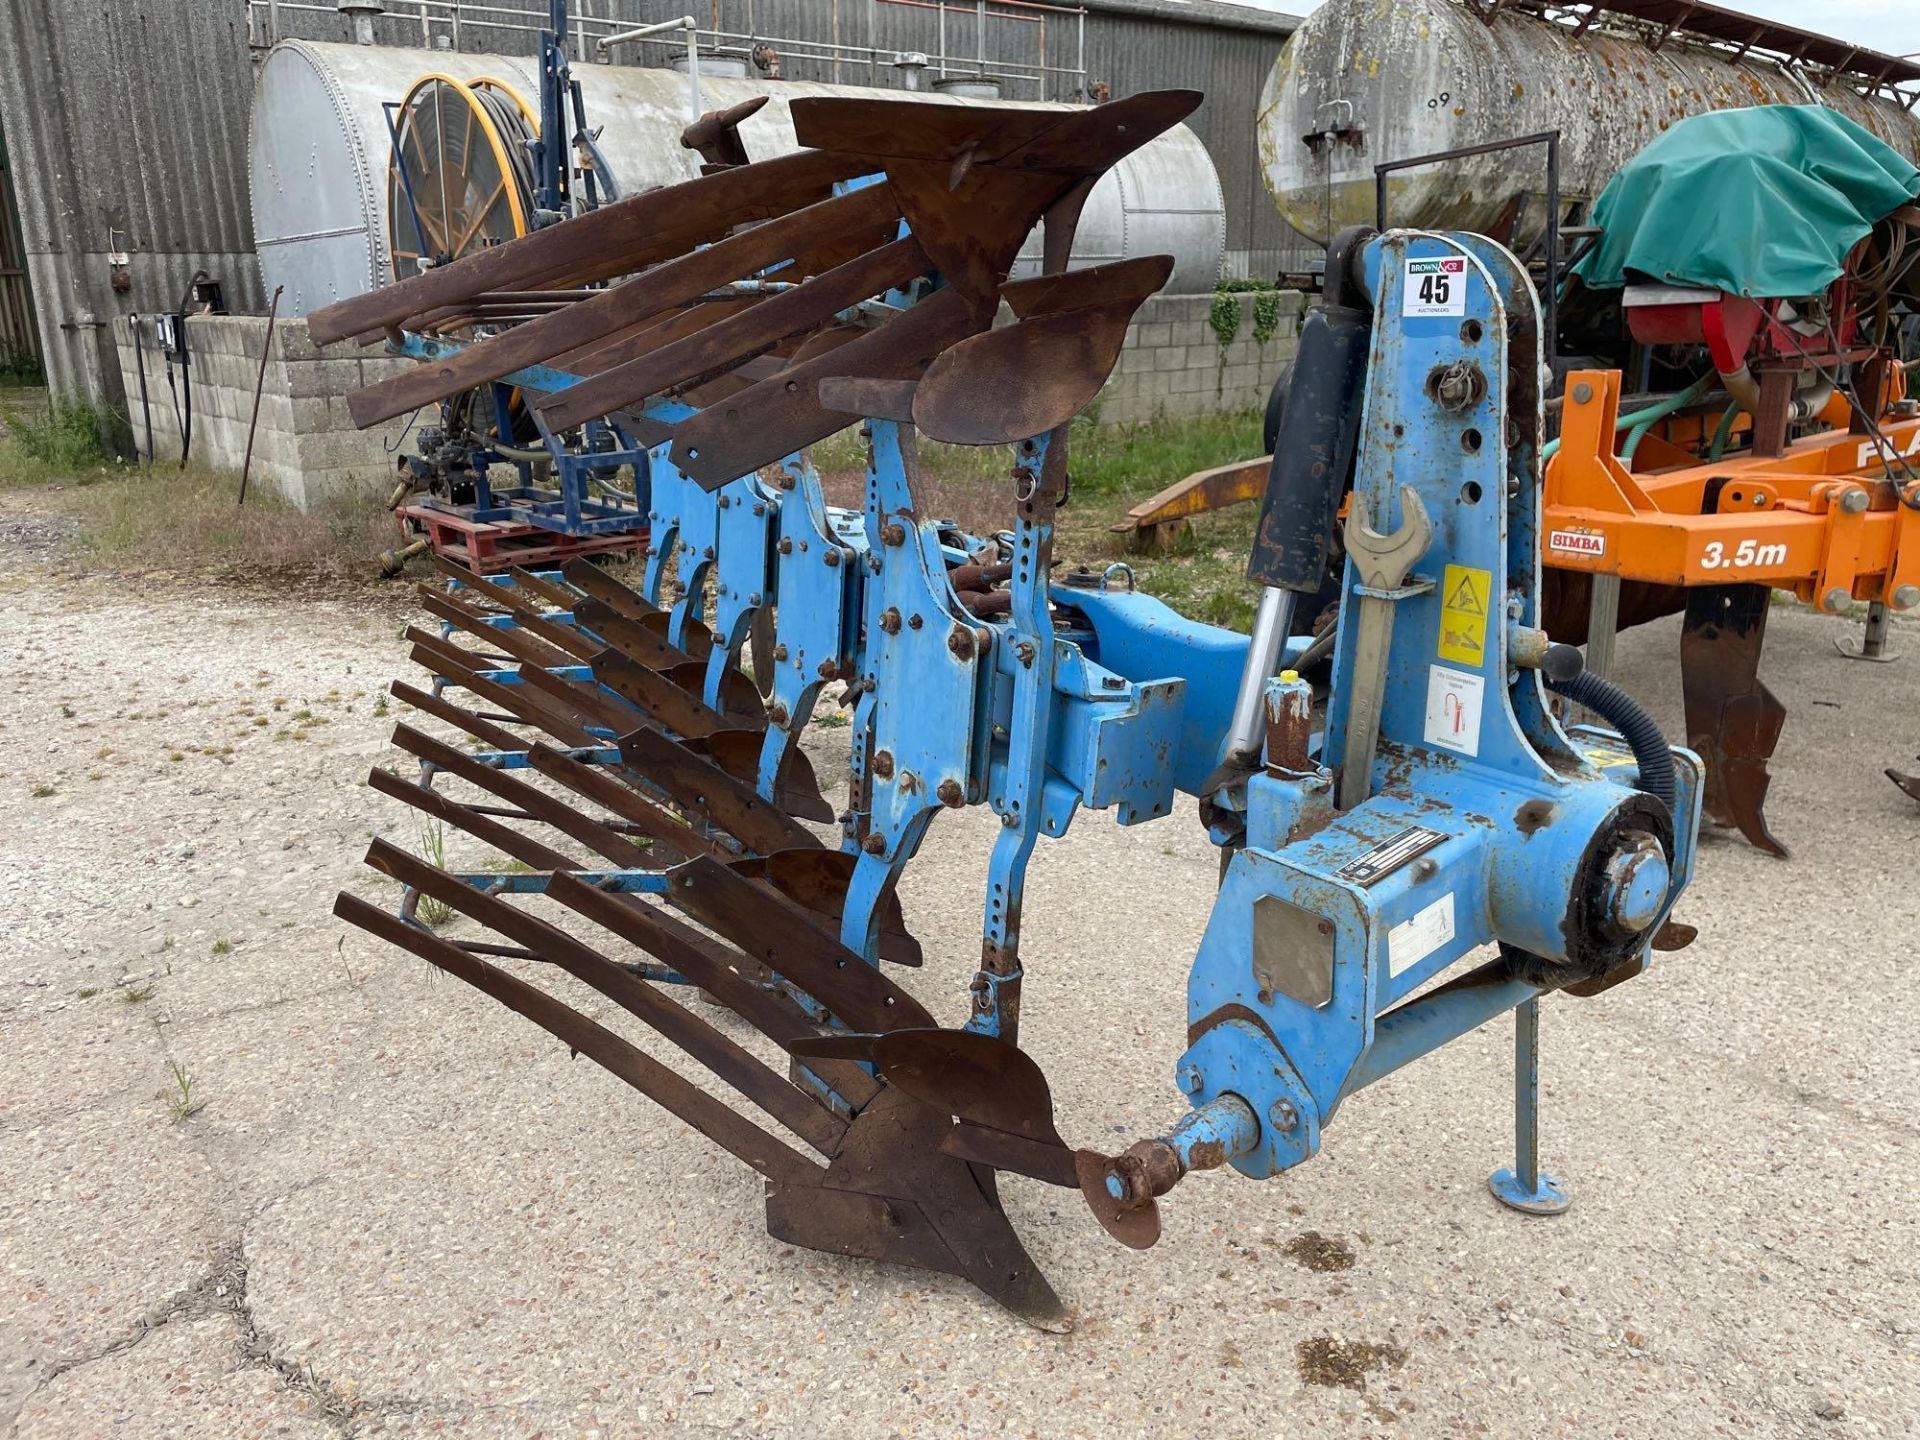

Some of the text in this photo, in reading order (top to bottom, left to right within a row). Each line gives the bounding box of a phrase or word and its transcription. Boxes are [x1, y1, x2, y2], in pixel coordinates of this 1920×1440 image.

[1419, 275, 1450, 304] 45
[1552, 533, 1602, 554] SIMBA
[1700, 539, 1788, 569] 3.5m
